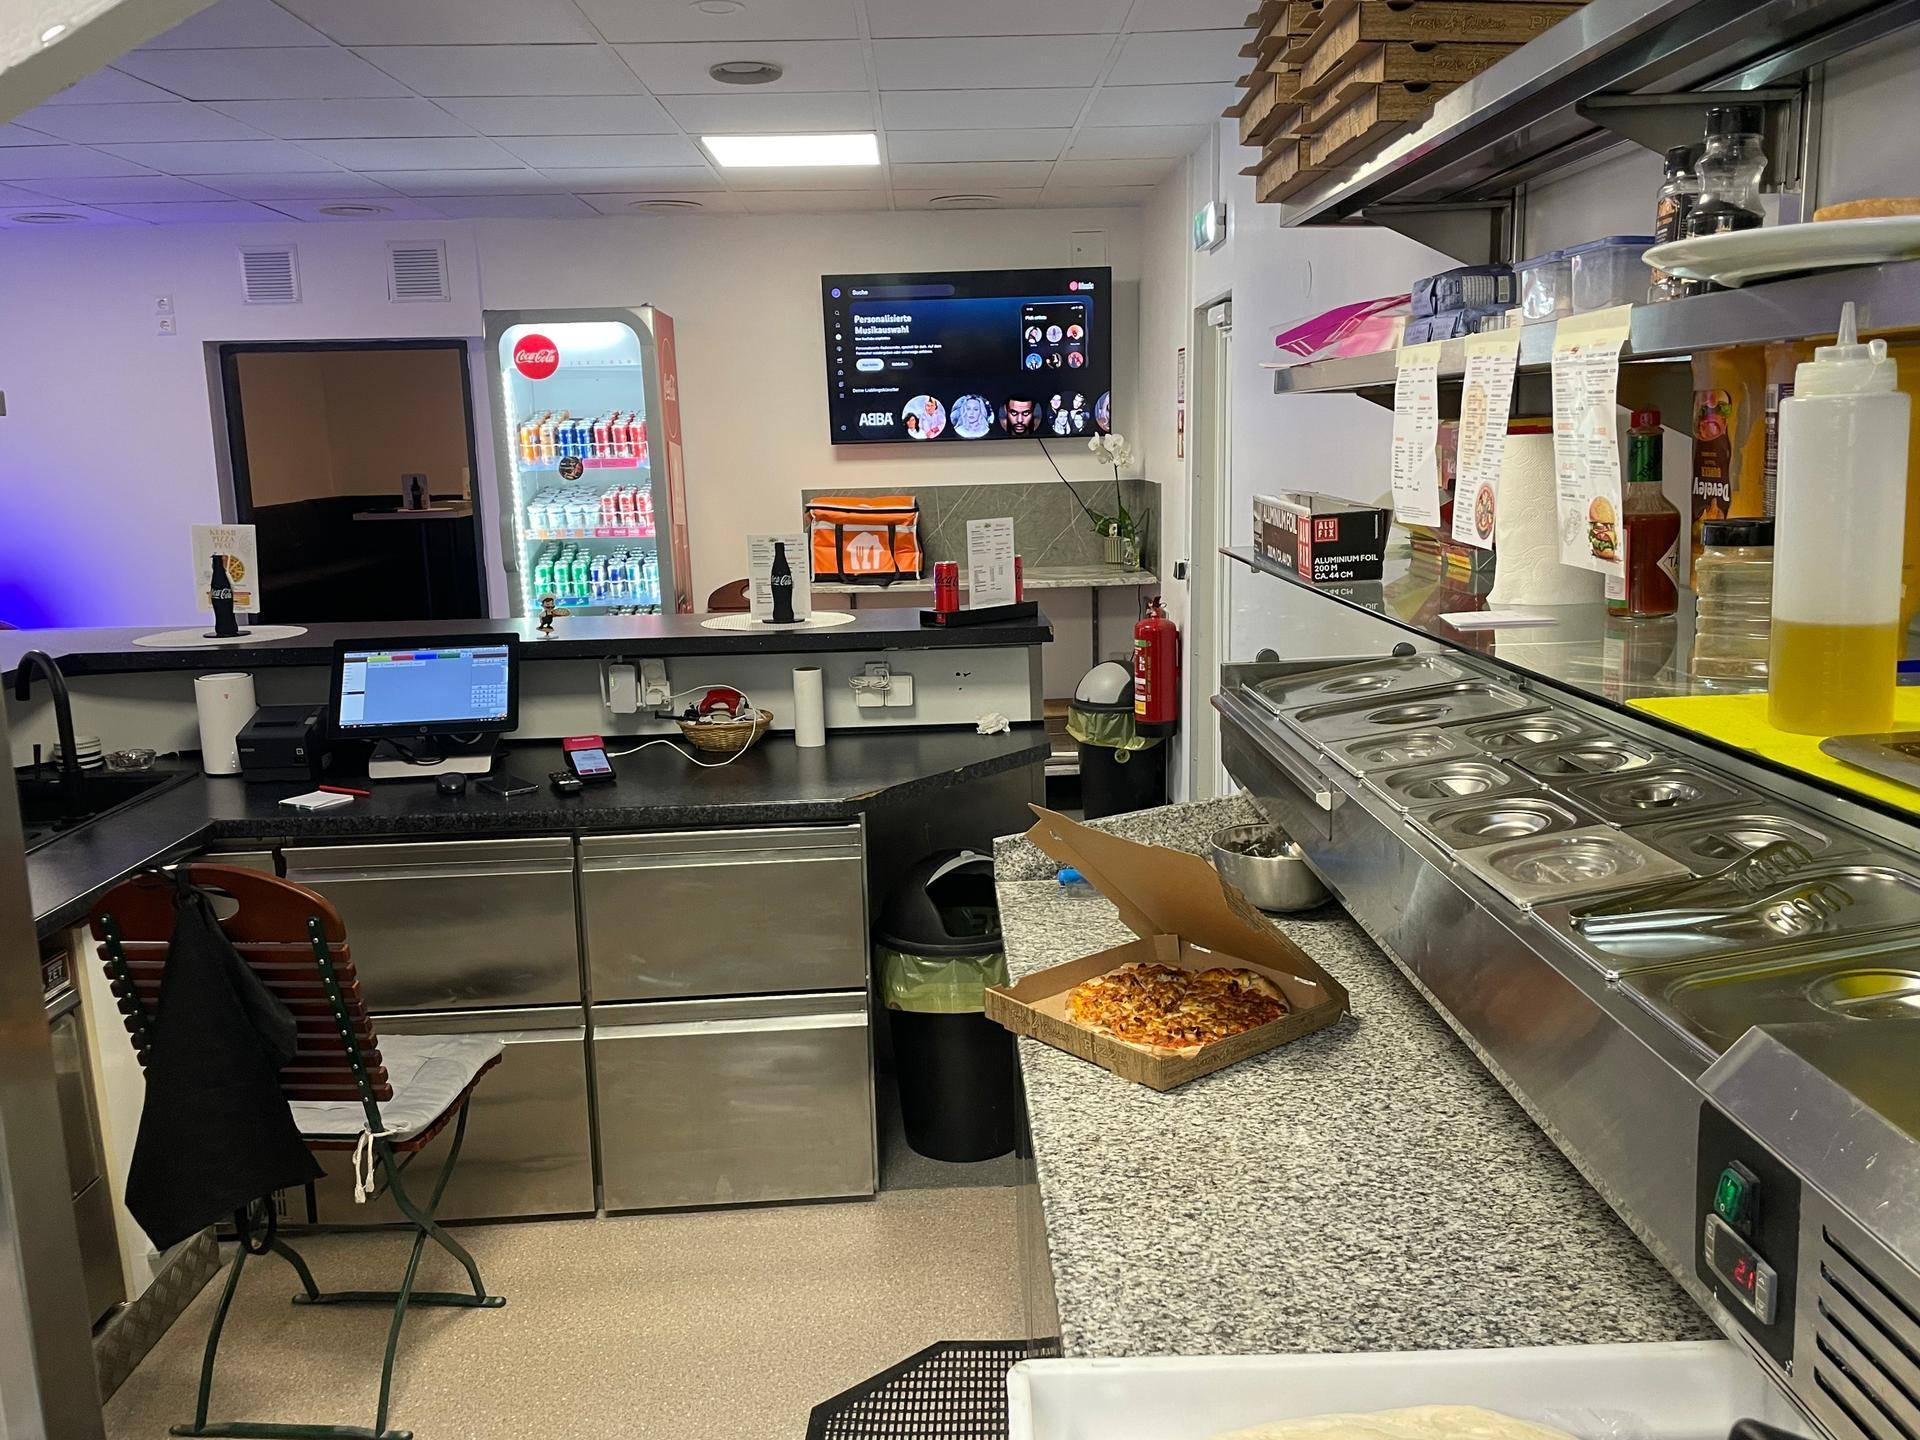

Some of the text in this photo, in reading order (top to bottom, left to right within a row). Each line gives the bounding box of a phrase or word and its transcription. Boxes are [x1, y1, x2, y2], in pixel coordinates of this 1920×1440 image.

[853, 313, 912, 324] Personalisierte
[854, 325, 910, 335] Musikauswahl
[858, 412, 894, 427] ABBA
[1692, 476, 1730, 502] Develey
[1318, 521, 1335, 530] ALU
[1317, 529, 1335, 538] FIX
[1314, 553, 1379, 565] ALUMINIUM FOIL
[1314, 564, 1330, 572] 200
[1314, 570, 1354, 580] CA. 44 CM
